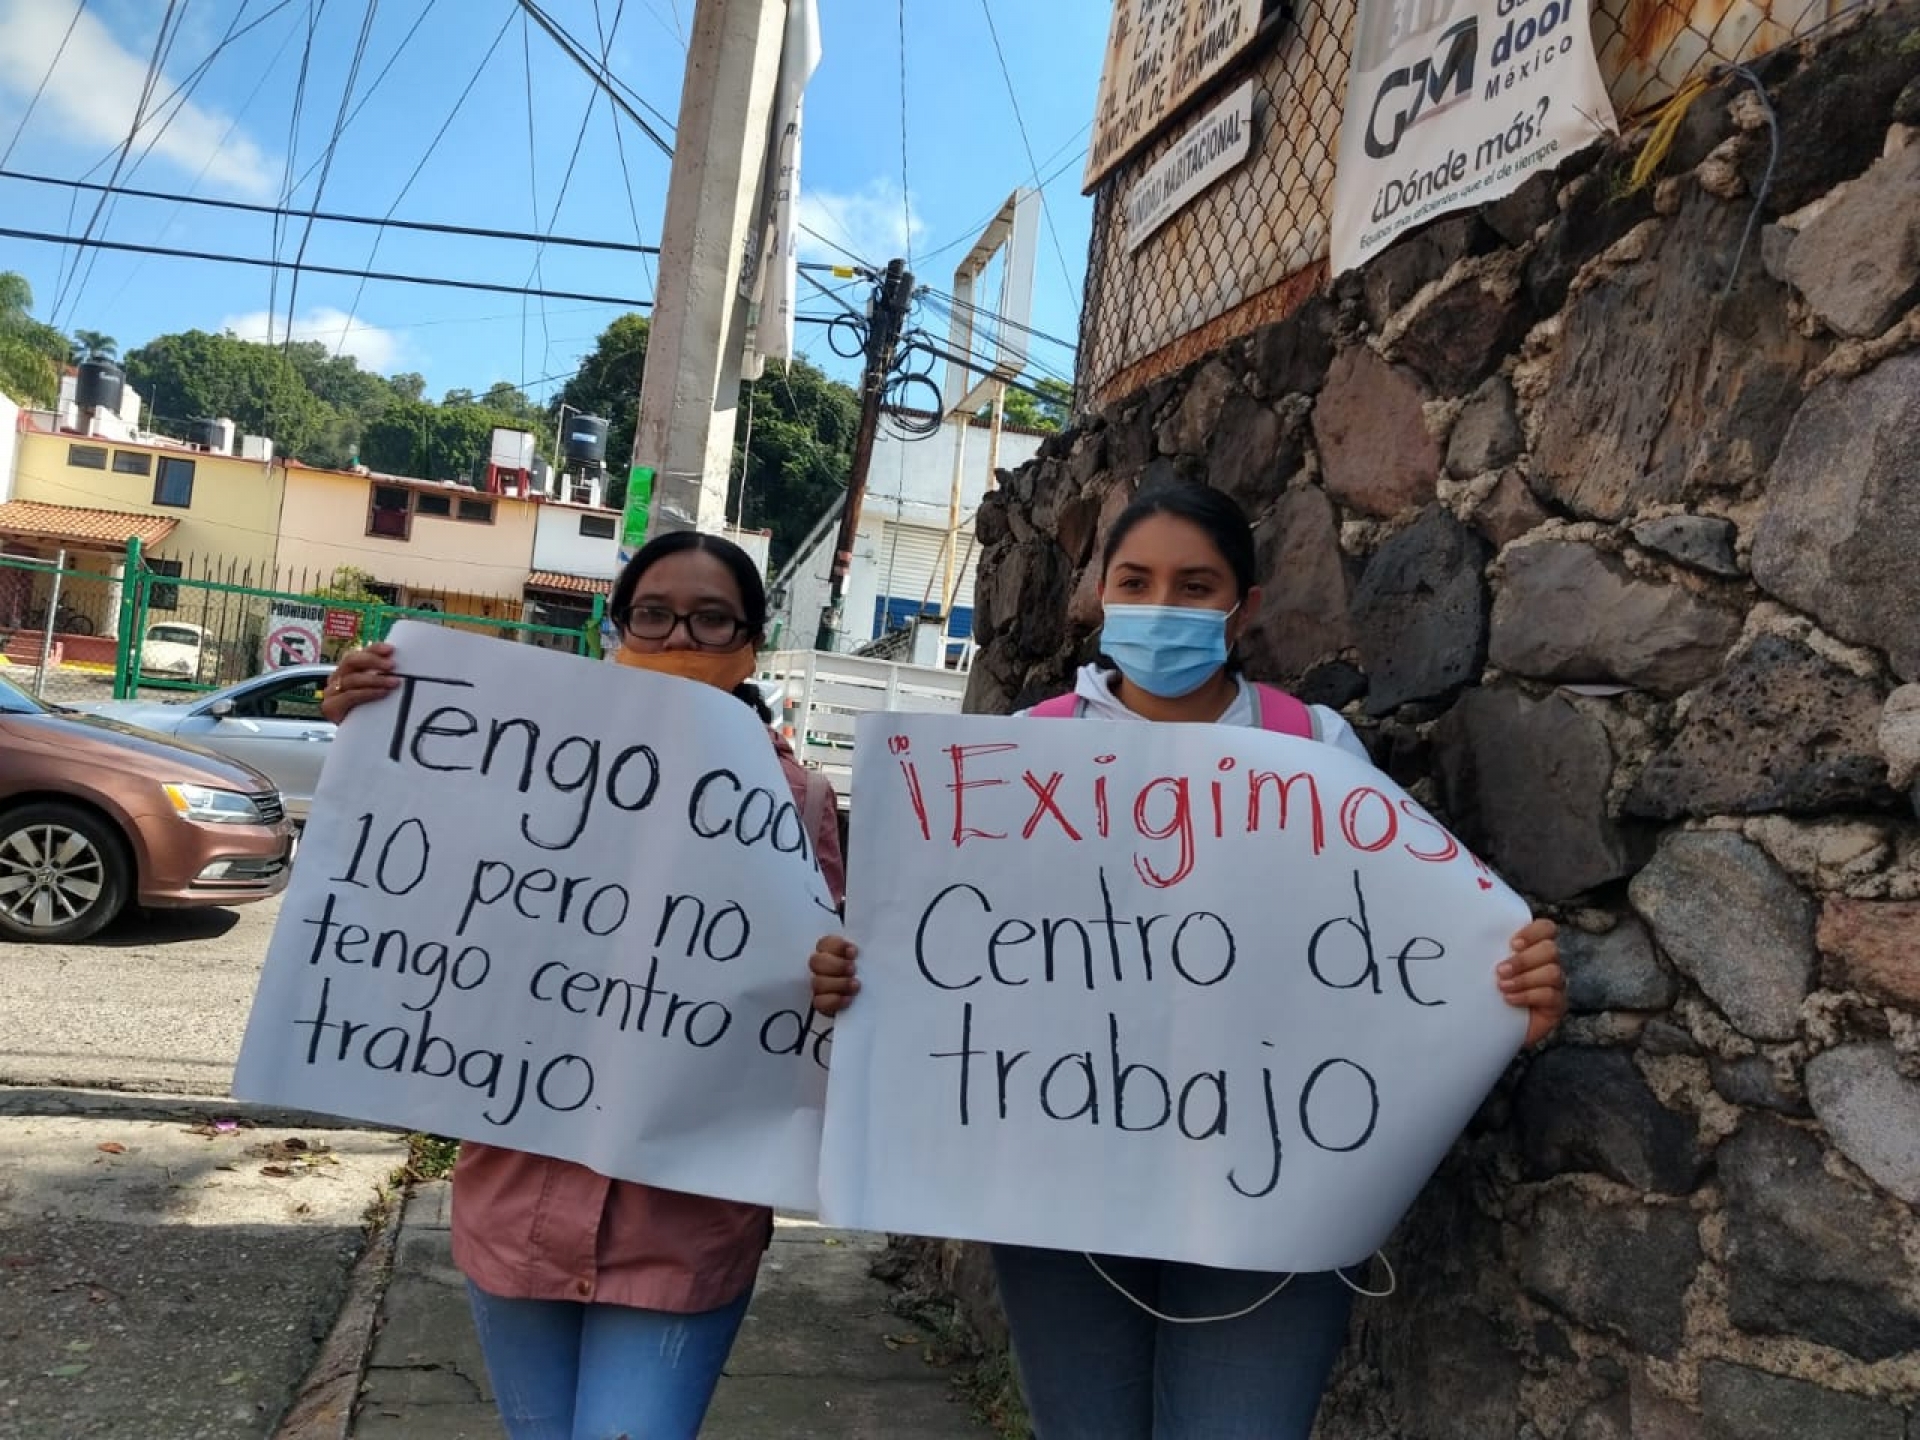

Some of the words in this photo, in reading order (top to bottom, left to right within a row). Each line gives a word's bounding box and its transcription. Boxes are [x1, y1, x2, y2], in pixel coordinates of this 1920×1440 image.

[1485, 35, 1573, 101] México
[1163, 109, 1242, 202] HABITACIONAL
[1371, 148, 1468, 224] ¿Dónde
[1475, 95, 1551, 171] más?
[388, 674, 660, 850] Tengo
[329, 813, 430, 895] 10
[456, 859, 629, 937] pero
[655, 892, 751, 962] no
[915, 865, 1237, 991] Centro
[1308, 870, 1447, 1006] de
[303, 893, 490, 1012] tengo
[530, 956, 733, 1048] centro
[930, 1002, 1379, 1198] trabajo
